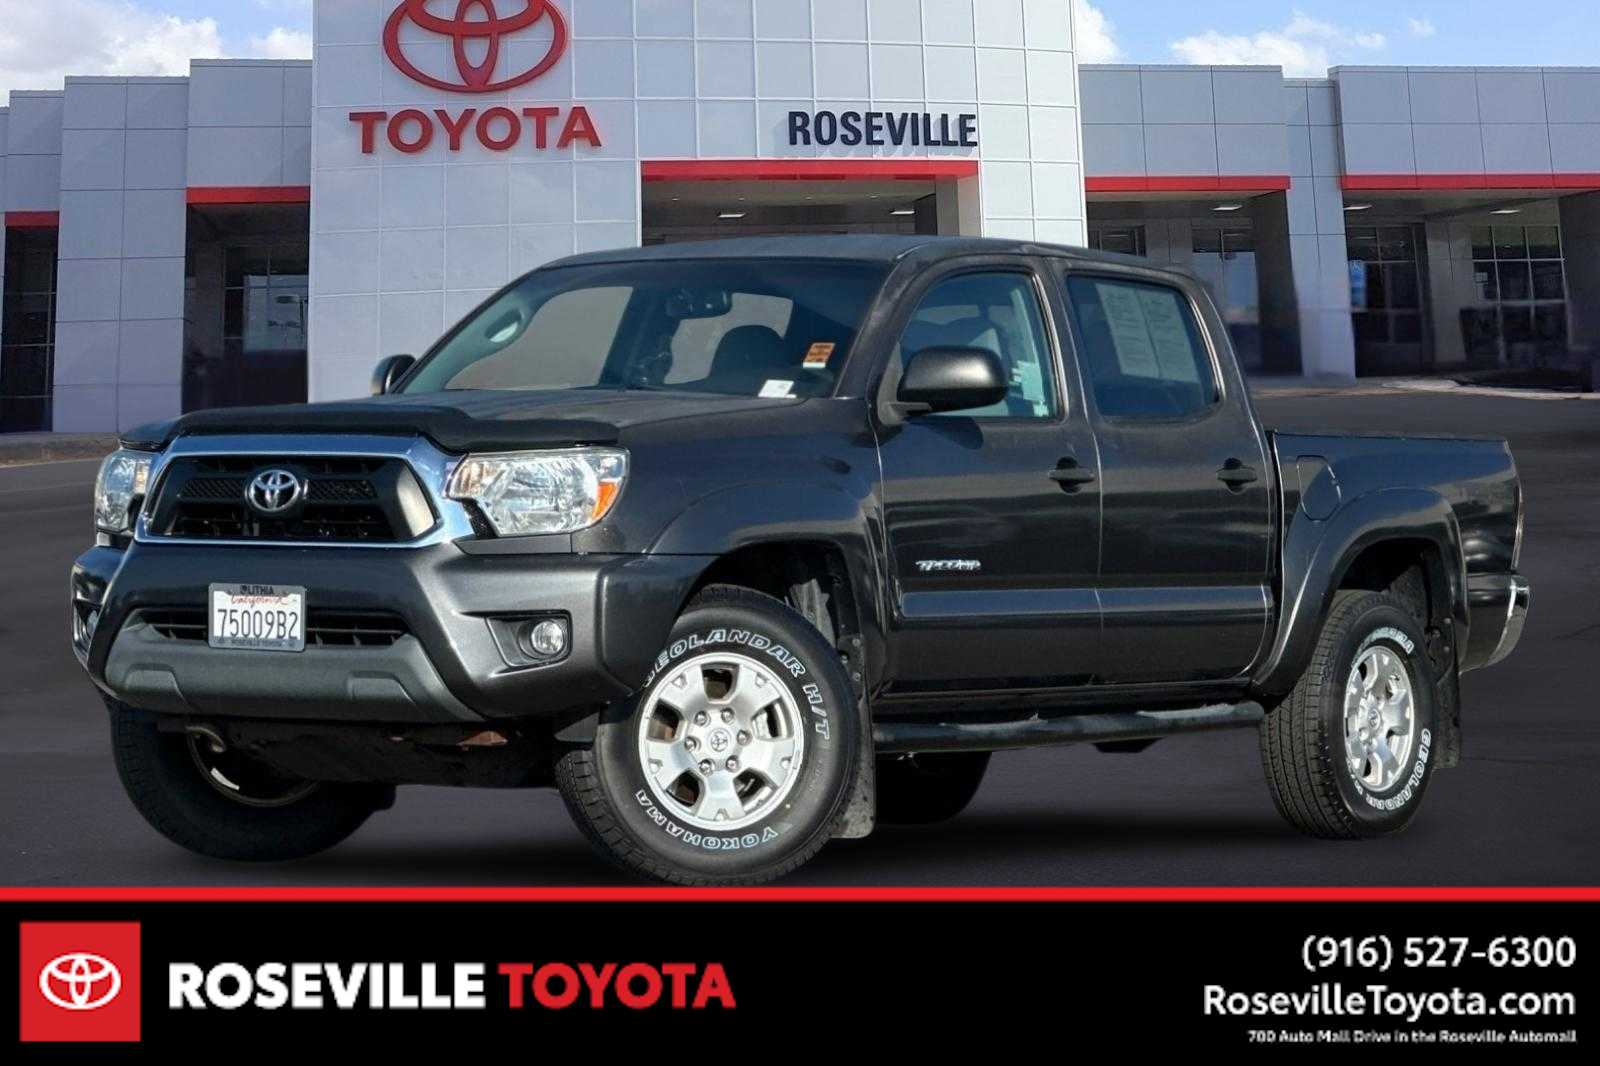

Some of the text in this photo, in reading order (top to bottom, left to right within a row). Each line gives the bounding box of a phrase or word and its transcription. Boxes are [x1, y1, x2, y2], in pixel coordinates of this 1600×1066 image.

[349, 106, 602, 154] TOYOTA
[788, 110, 978, 147] ROSEVILLE
[217, 608, 298, 640] 75009B2
[803, 683, 830, 740] H/T
[635, 789, 779, 850] YOKOHAMA
